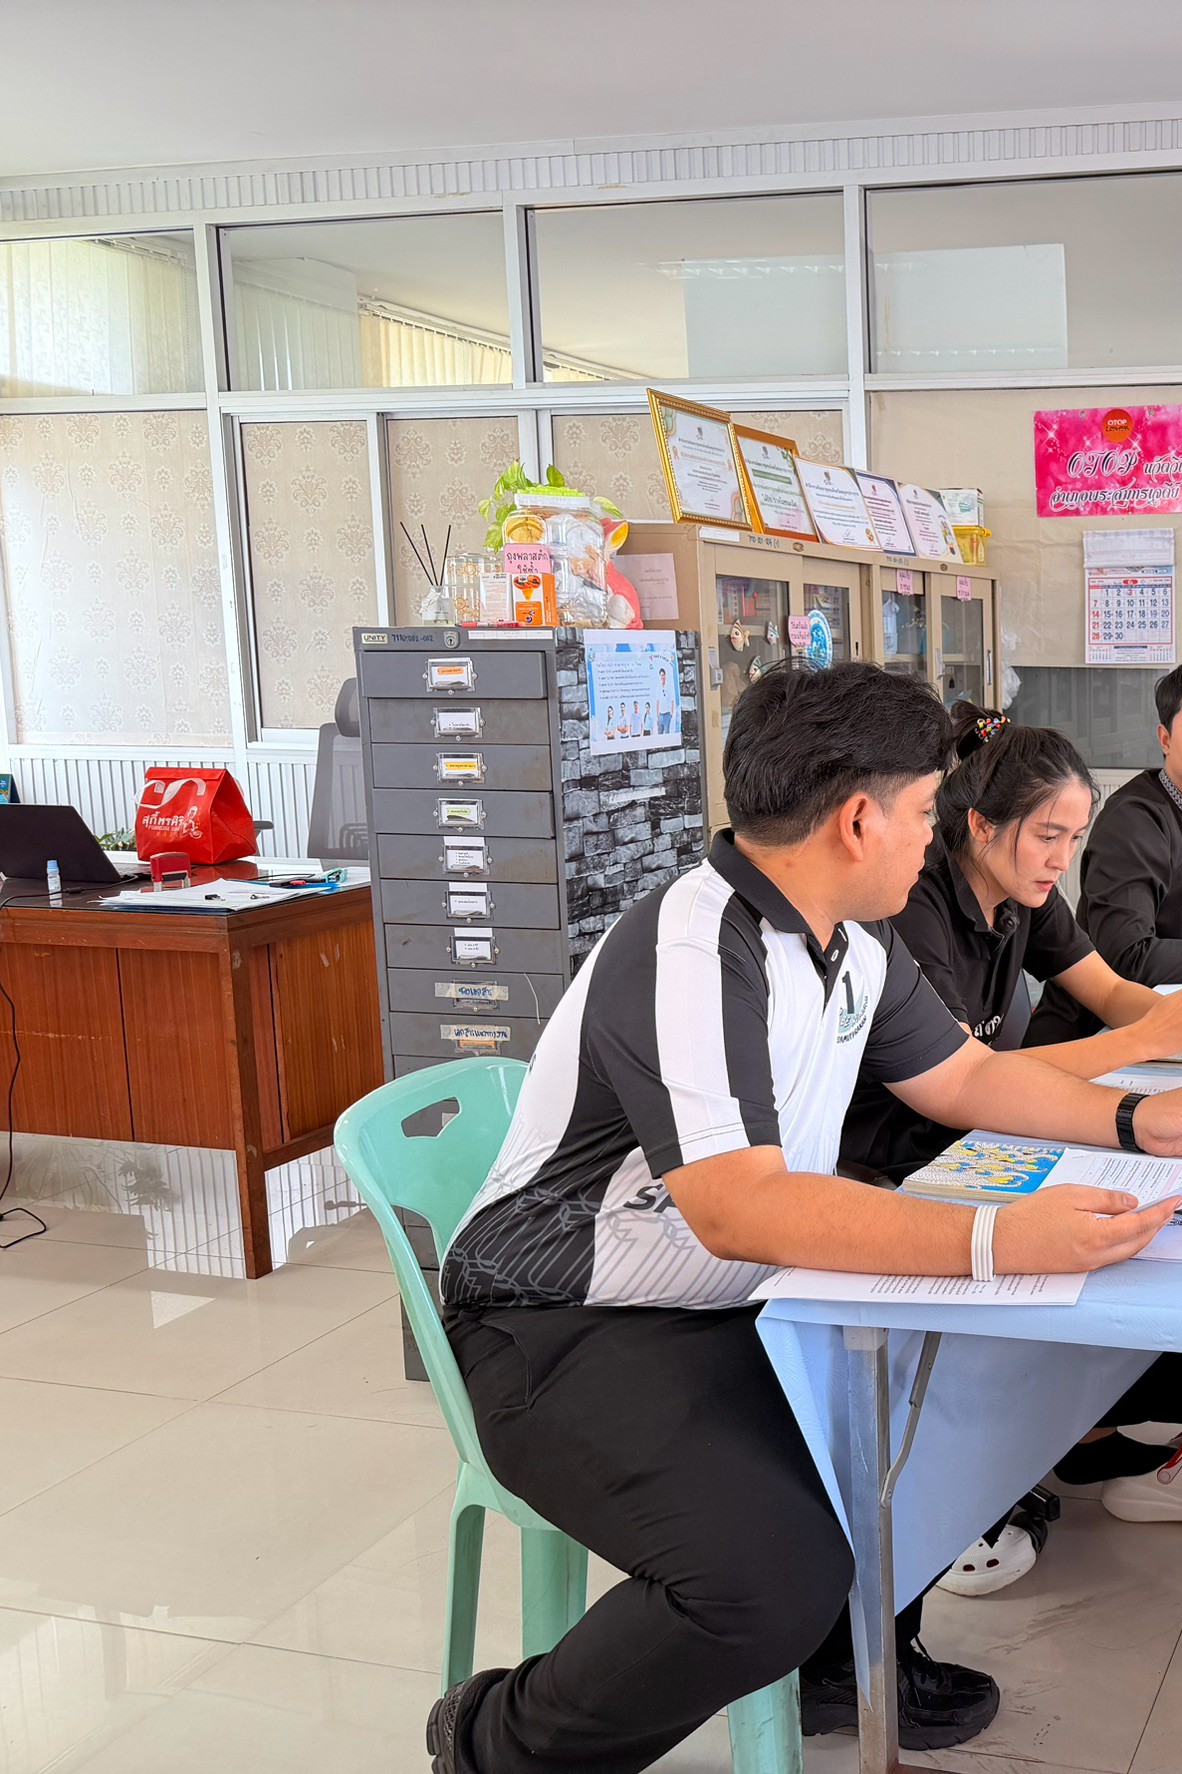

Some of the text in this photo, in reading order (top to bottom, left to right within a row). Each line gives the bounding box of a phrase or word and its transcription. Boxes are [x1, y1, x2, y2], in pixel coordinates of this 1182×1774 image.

[1067, 449, 1139, 478] OTOP
[1127, 599, 1135, 607] 10
[1139, 599, 1145, 607] 11
[1104, 610, 1111, 618] 15
[1115, 610, 1123, 618] 16
[1127, 610, 1134, 618] 17
[1139, 610, 1146, 618] 18
[1092, 621, 1099, 629] 21
[1103, 621, 1112, 629] 22
[1115, 621, 1123, 629] 23
[1126, 621, 1135, 629] 24
[1149, 620, 1158, 628] 26
[1161, 620, 1169, 628] 27
[363, 634, 386, 642] UNITY
[1092, 632, 1123, 640] 28 29 30
[842, 971, 854, 1014] 1
